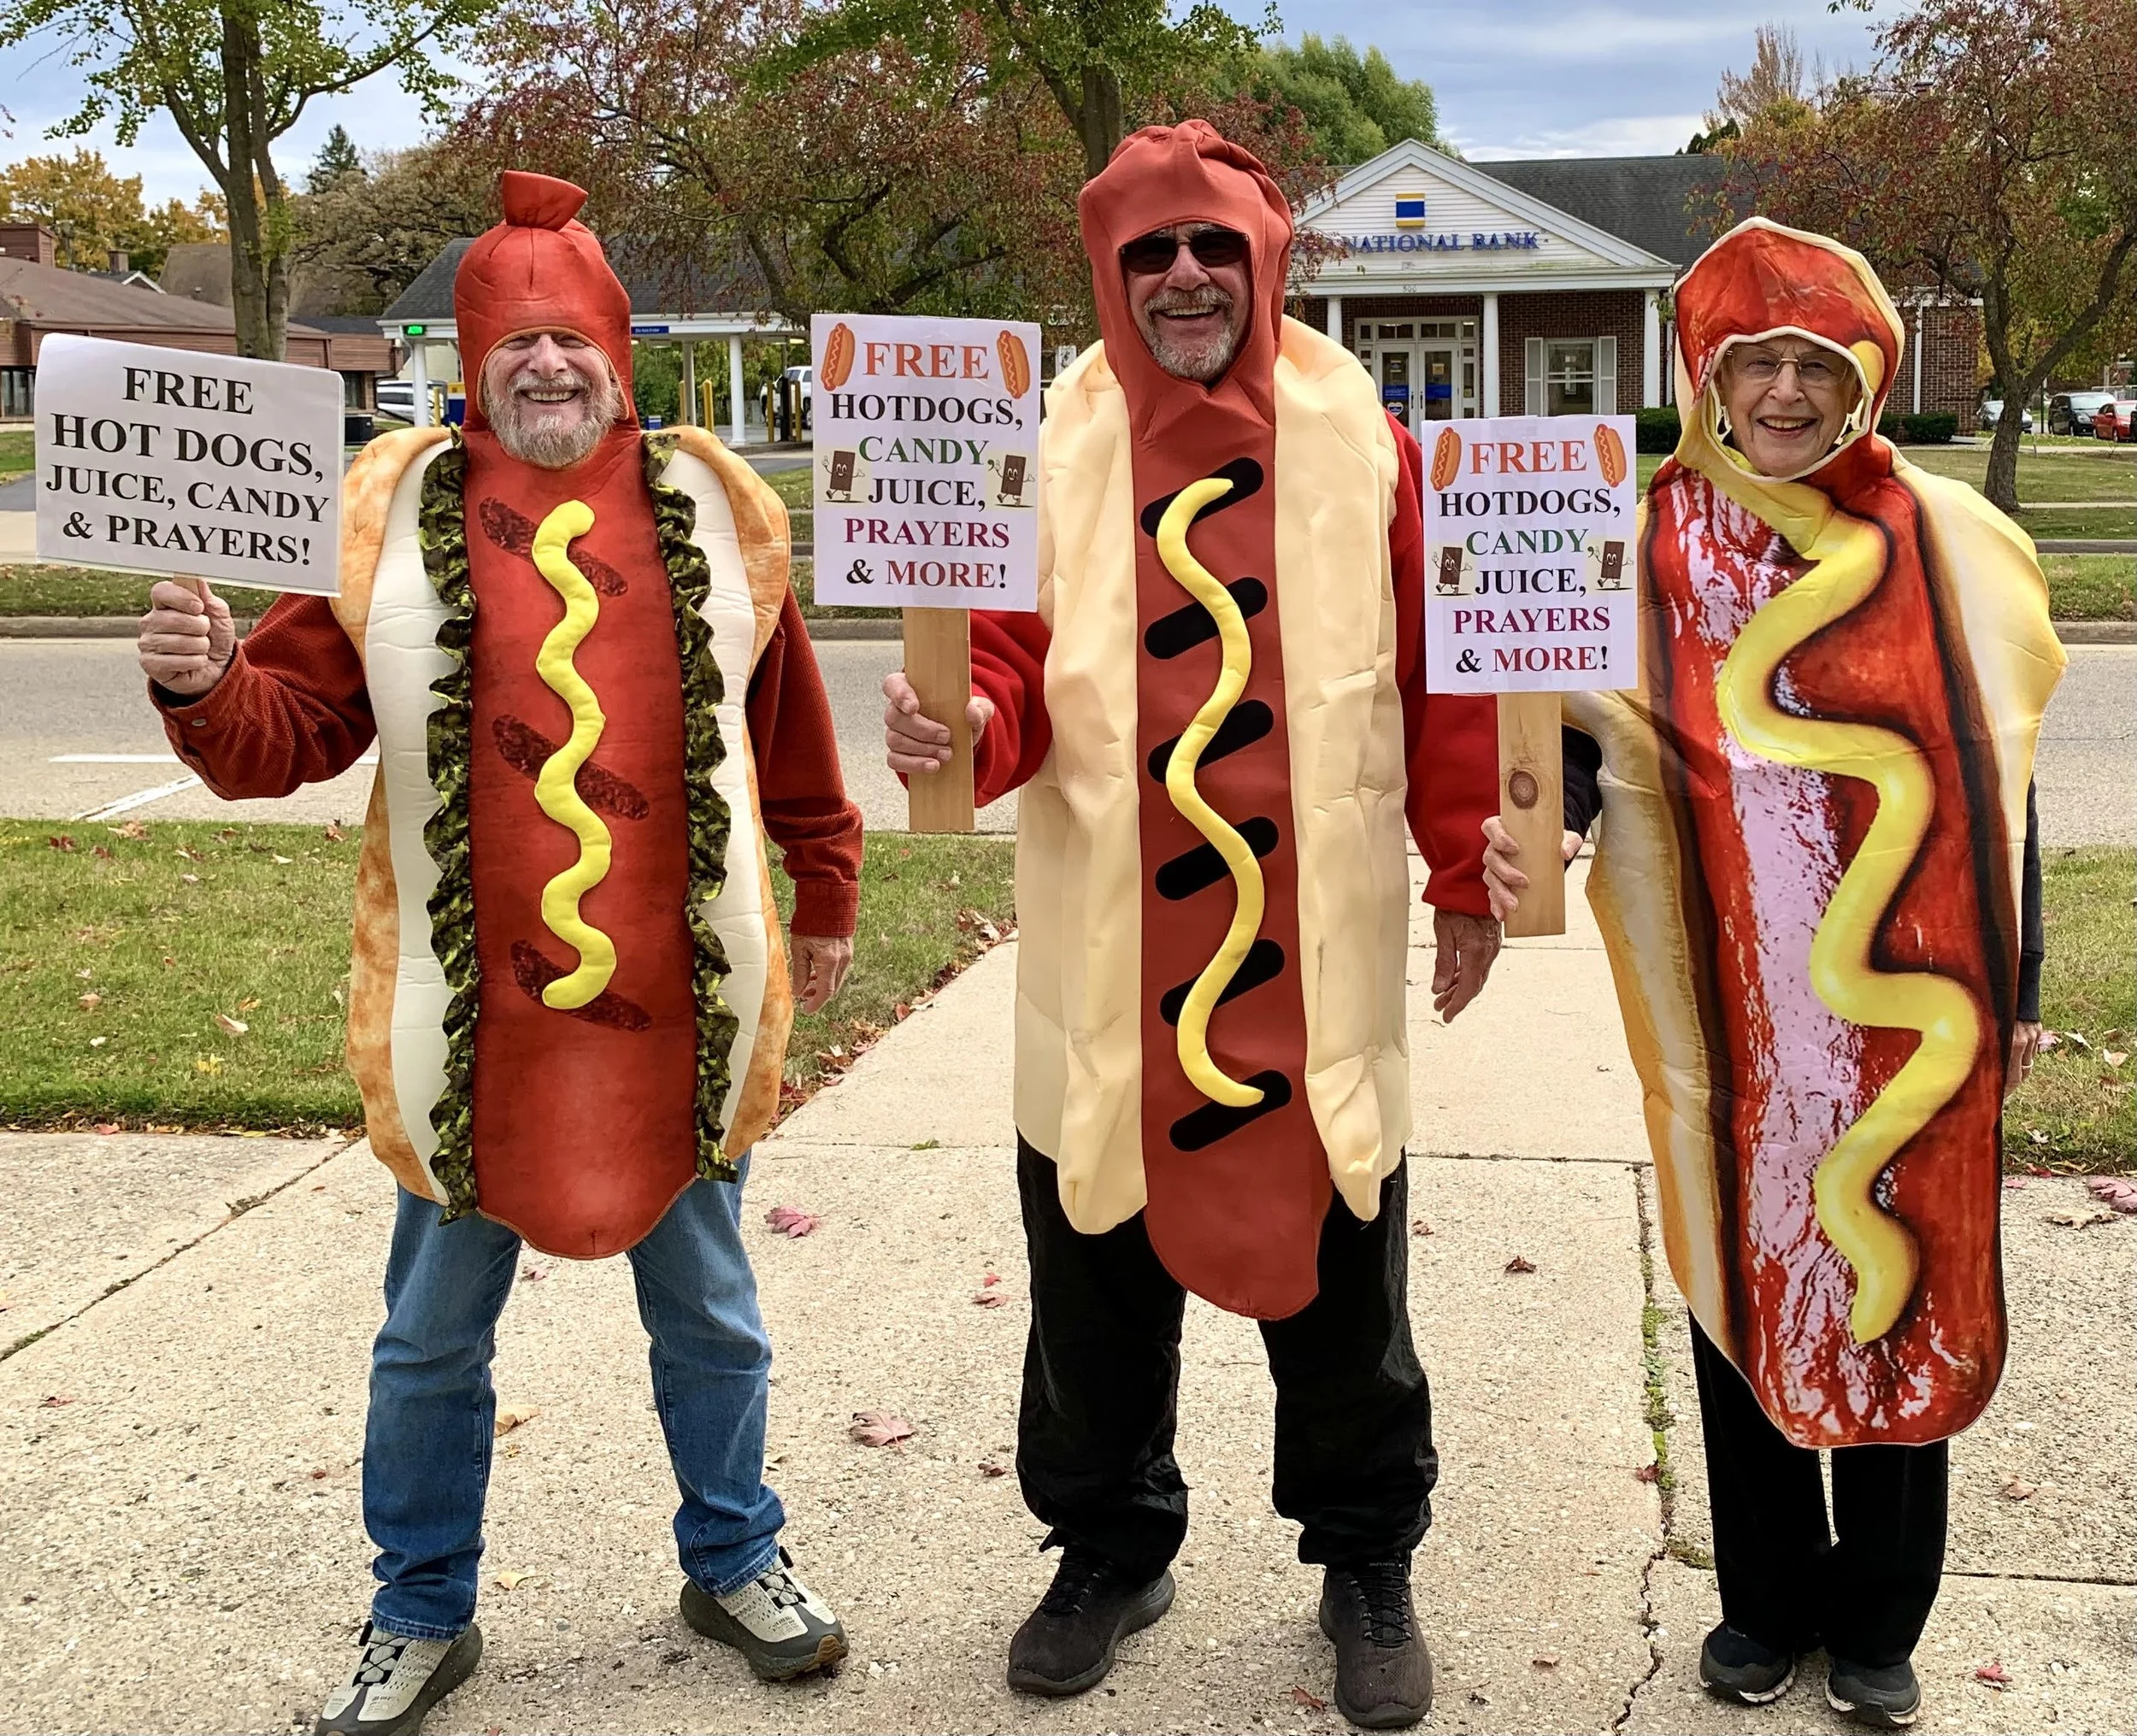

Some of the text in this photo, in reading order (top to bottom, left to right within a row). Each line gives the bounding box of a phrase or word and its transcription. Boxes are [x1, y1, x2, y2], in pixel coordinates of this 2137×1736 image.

[1341, 232, 1463, 254] NATIONAL
[1471, 232, 1539, 251] BANK
[863, 343, 989, 380] FREE
[122, 367, 253, 415] FREE
[831, 394, 1022, 431] HOTDOGS,
[50, 413, 322, 483] HOT DOGS,
[859, 437, 994, 470] CANDY,
[1469, 441, 1587, 474] FREE
[46, 464, 329, 522] JUICE, CANDY
[868, 479, 985, 512] JUICE,
[1439, 489, 1620, 517] HOTDOGS,
[63, 512, 309, 565] & PRAYERS!
[845, 519, 1009, 548] PRAYERS
[1467, 529, 1594, 557] CANDY,
[846, 559, 1005, 588] & MORE!
[1475, 568, 1586, 597] JUICE,
[1453, 607, 1610, 633] PRAYERS
[1456, 646, 1607, 673] & MORE!
